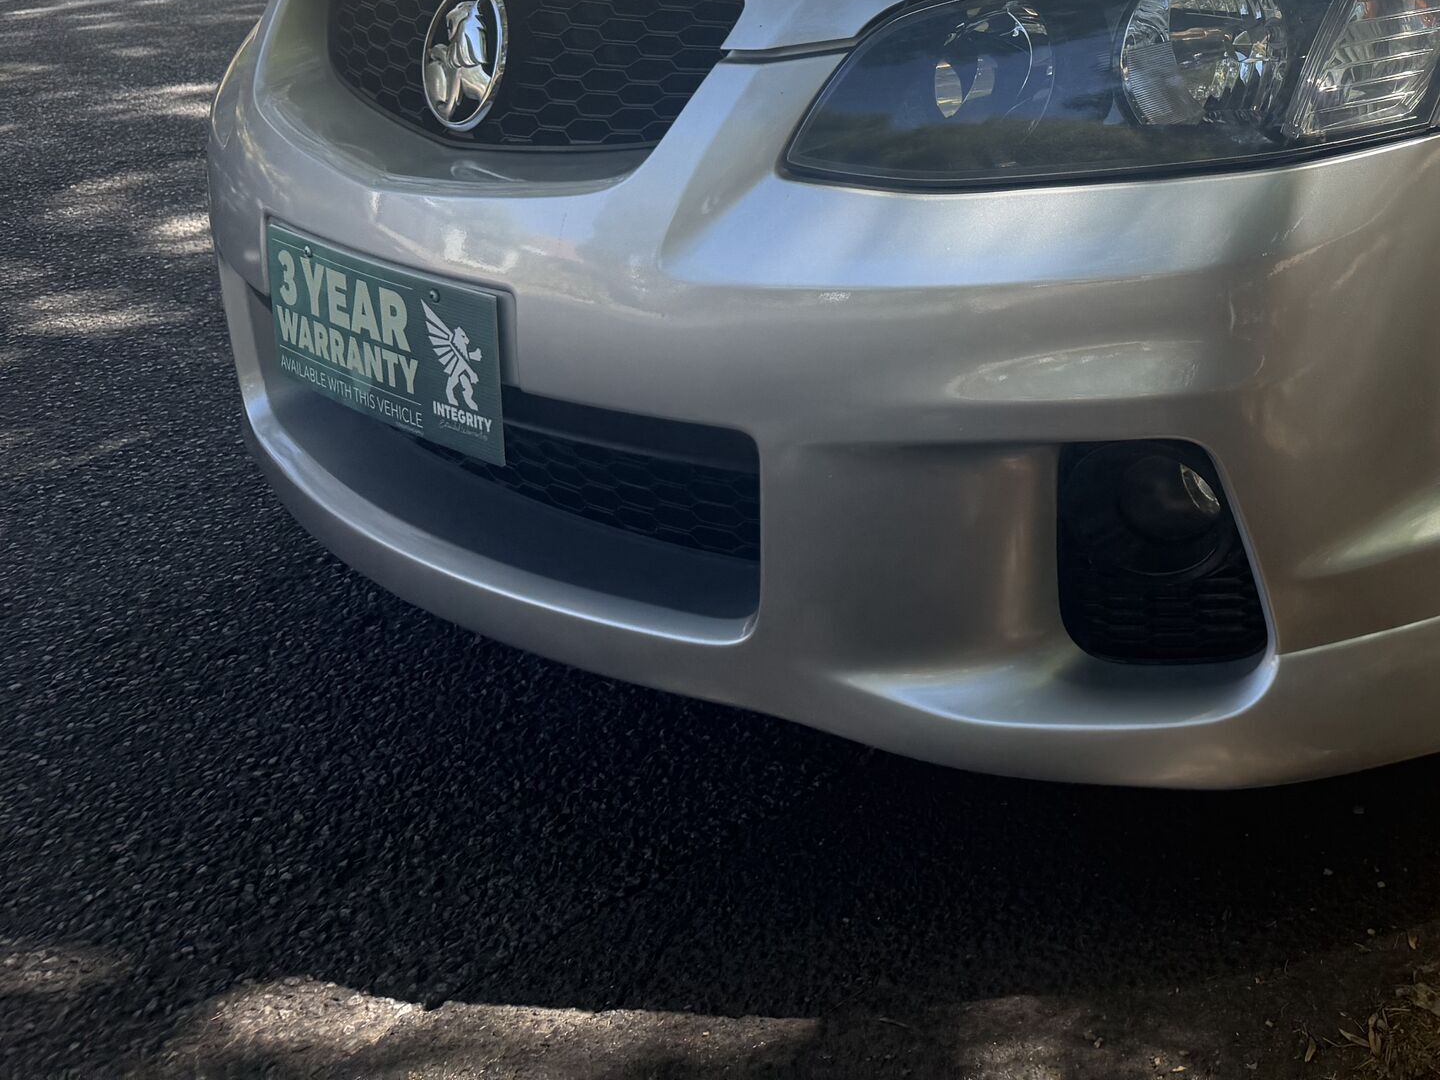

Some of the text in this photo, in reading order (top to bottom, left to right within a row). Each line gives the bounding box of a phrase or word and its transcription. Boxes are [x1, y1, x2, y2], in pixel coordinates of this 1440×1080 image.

[278, 250, 411, 352] 3 YEAR
[277, 304, 418, 394] WARRANTY
[281, 354, 423, 428] AVAILABLE WITH THIS VEHICLE
[433, 401, 492, 432] INTEGRITY
